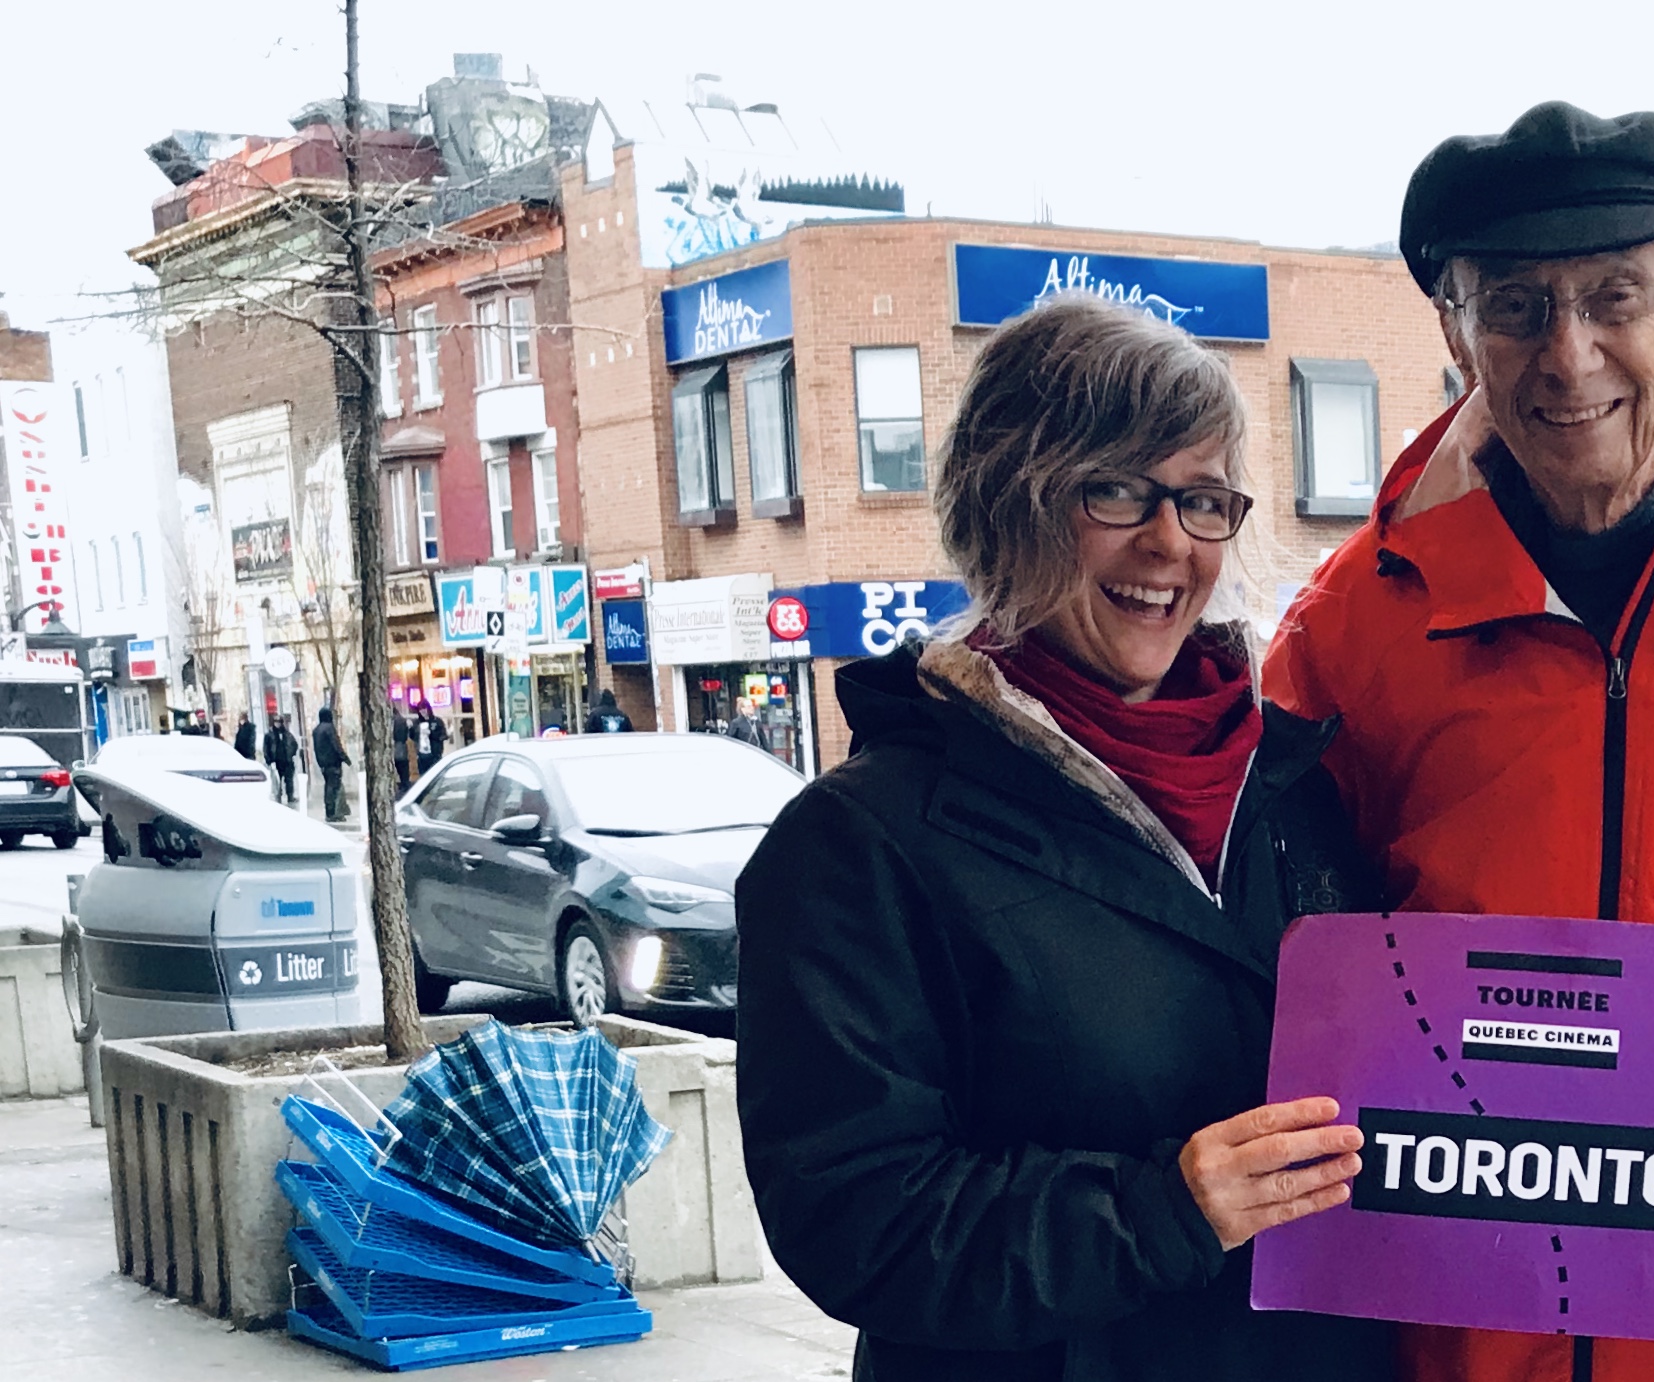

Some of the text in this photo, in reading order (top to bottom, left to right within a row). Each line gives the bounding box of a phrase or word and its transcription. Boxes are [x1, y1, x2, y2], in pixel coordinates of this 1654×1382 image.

[1034, 256, 1192, 312] Altima
[695, 282, 764, 331] Altima
[695, 317, 763, 355] DENTAL
[732, 596, 765, 606] Presse
[776, 604, 800, 619] PI
[861, 582, 927, 618] PI
[606, 634, 642, 650] DENTAL
[276, 952, 326, 983] Litter
[1477, 984, 1610, 1012] TOURNÉE
[1469, 1025, 1613, 1047] QUÉBEC CINÉMA
